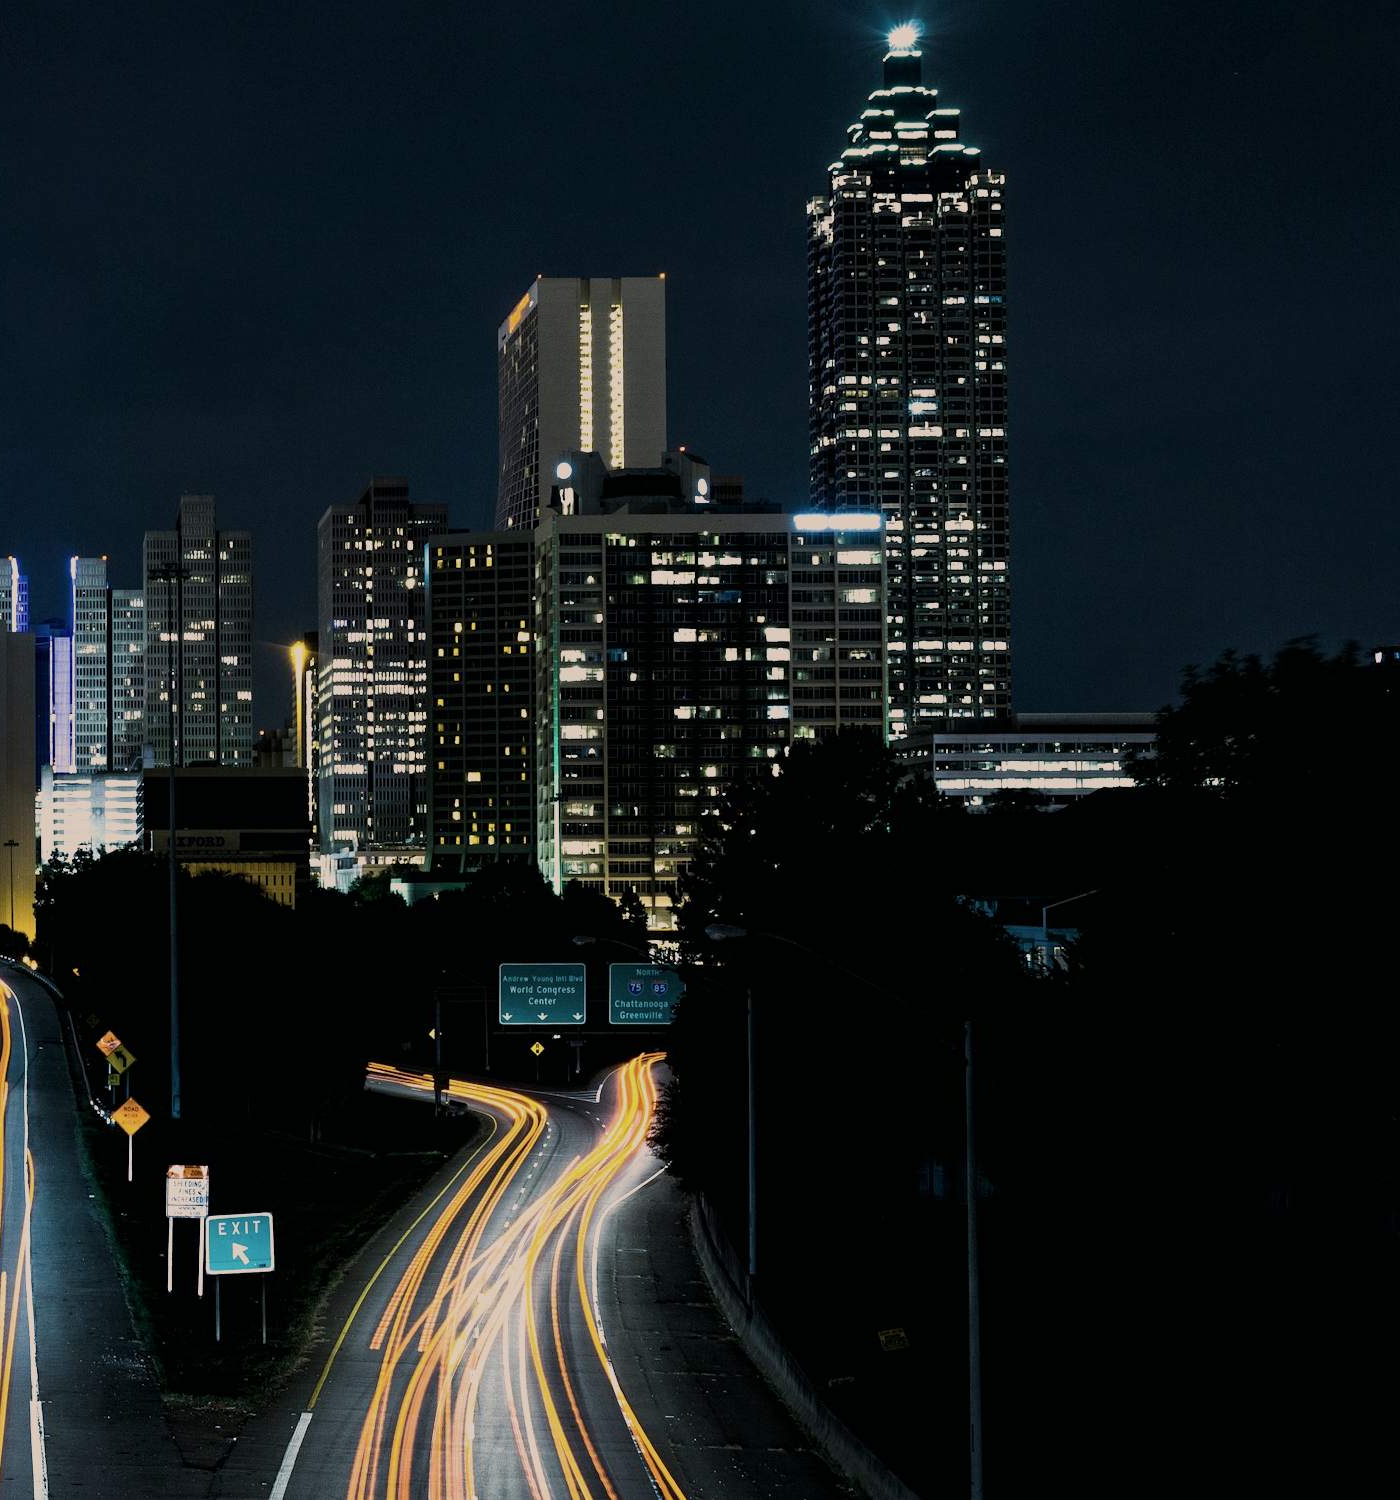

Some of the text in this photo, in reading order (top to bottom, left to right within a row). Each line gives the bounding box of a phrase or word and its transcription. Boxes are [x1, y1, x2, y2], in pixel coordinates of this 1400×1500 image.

[168, 836, 225, 847] XFORD
[533, 975, 554, 984] Young
[509, 986, 576, 996] World Congress
[630, 983, 666, 993] 75 85
[528, 997, 557, 1006] Center
[614, 1000, 669, 1010] Chattanooga
[620, 1011, 663, 1019] Greenville
[218, 1220, 261, 1236] EXIT
